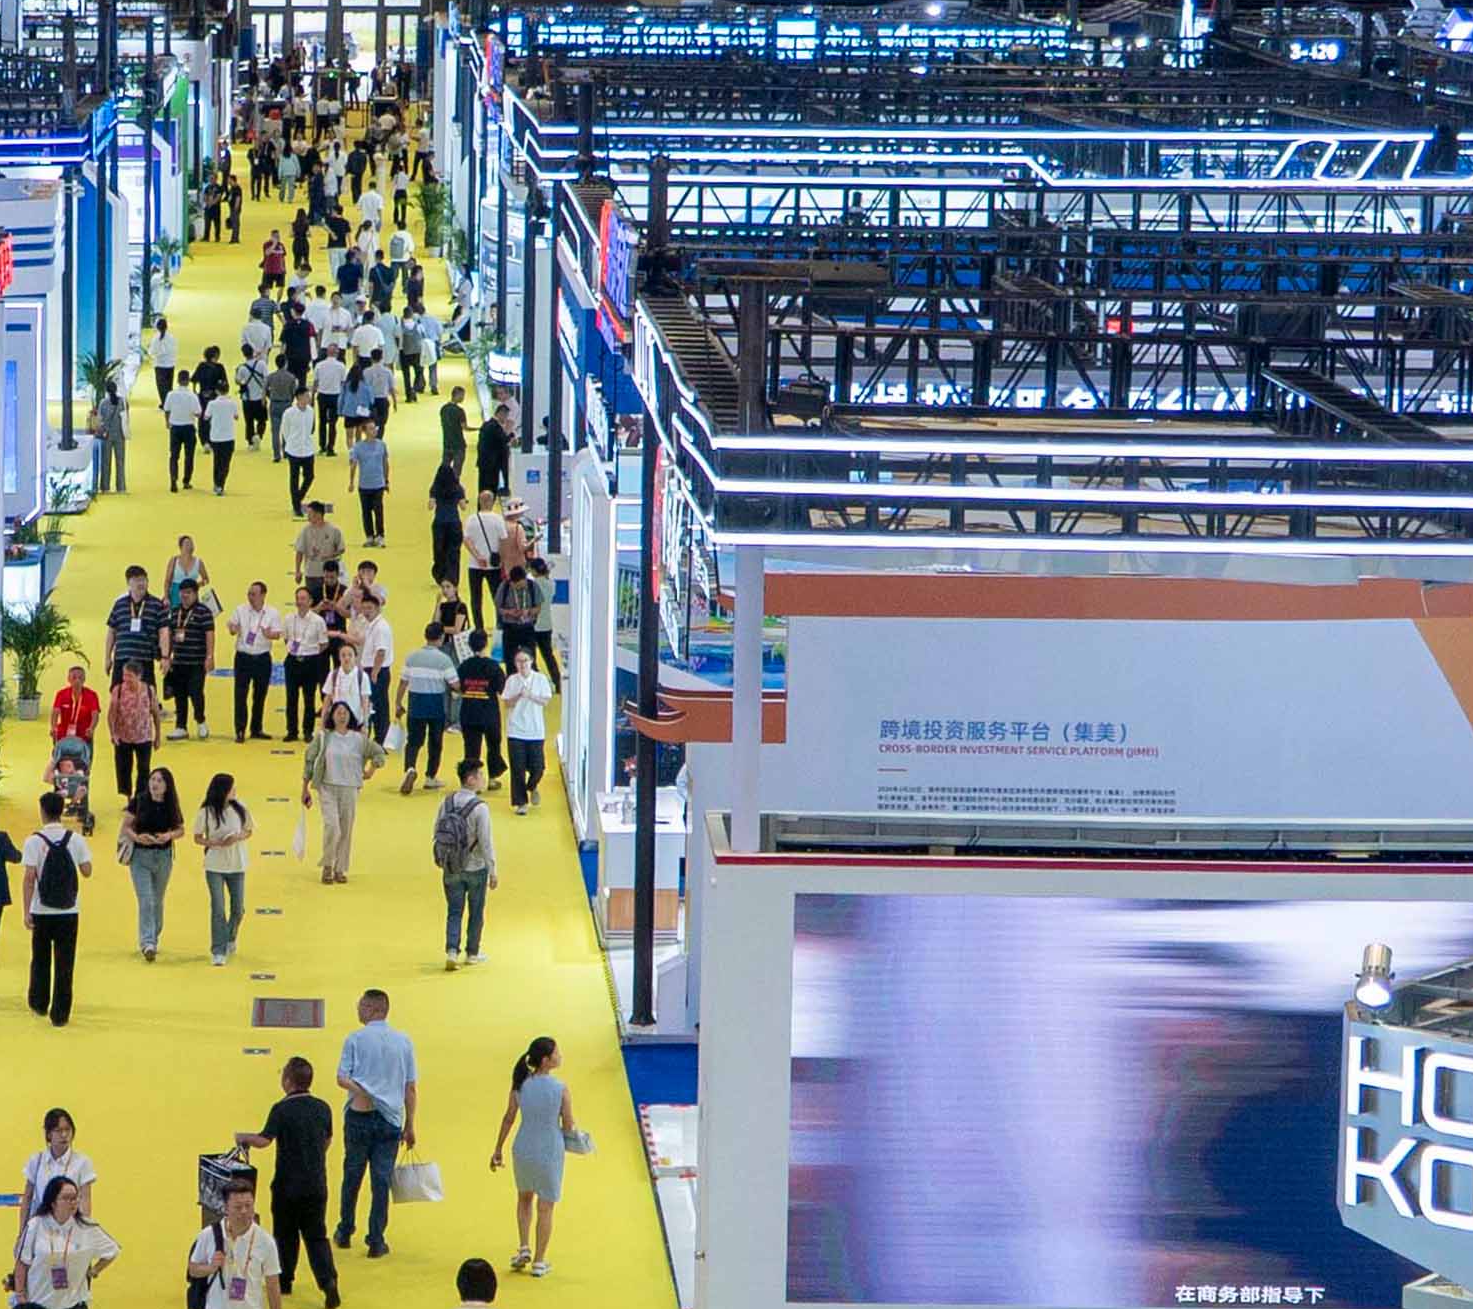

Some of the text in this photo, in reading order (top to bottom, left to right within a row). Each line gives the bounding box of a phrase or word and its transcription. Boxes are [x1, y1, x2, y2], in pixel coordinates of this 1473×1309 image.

[880, 720, 1129, 743] 跨境投资服务平台（集美）
[878, 743, 957, 754] CROSS-BORDER
[960, 745, 1024, 755] INVESTMENT
[1027, 746, 1067, 756] SERVICE
[1070, 747, 1124, 757] PLATFORM
[1175, 1285, 1325, 1304] 在商务部指导下
